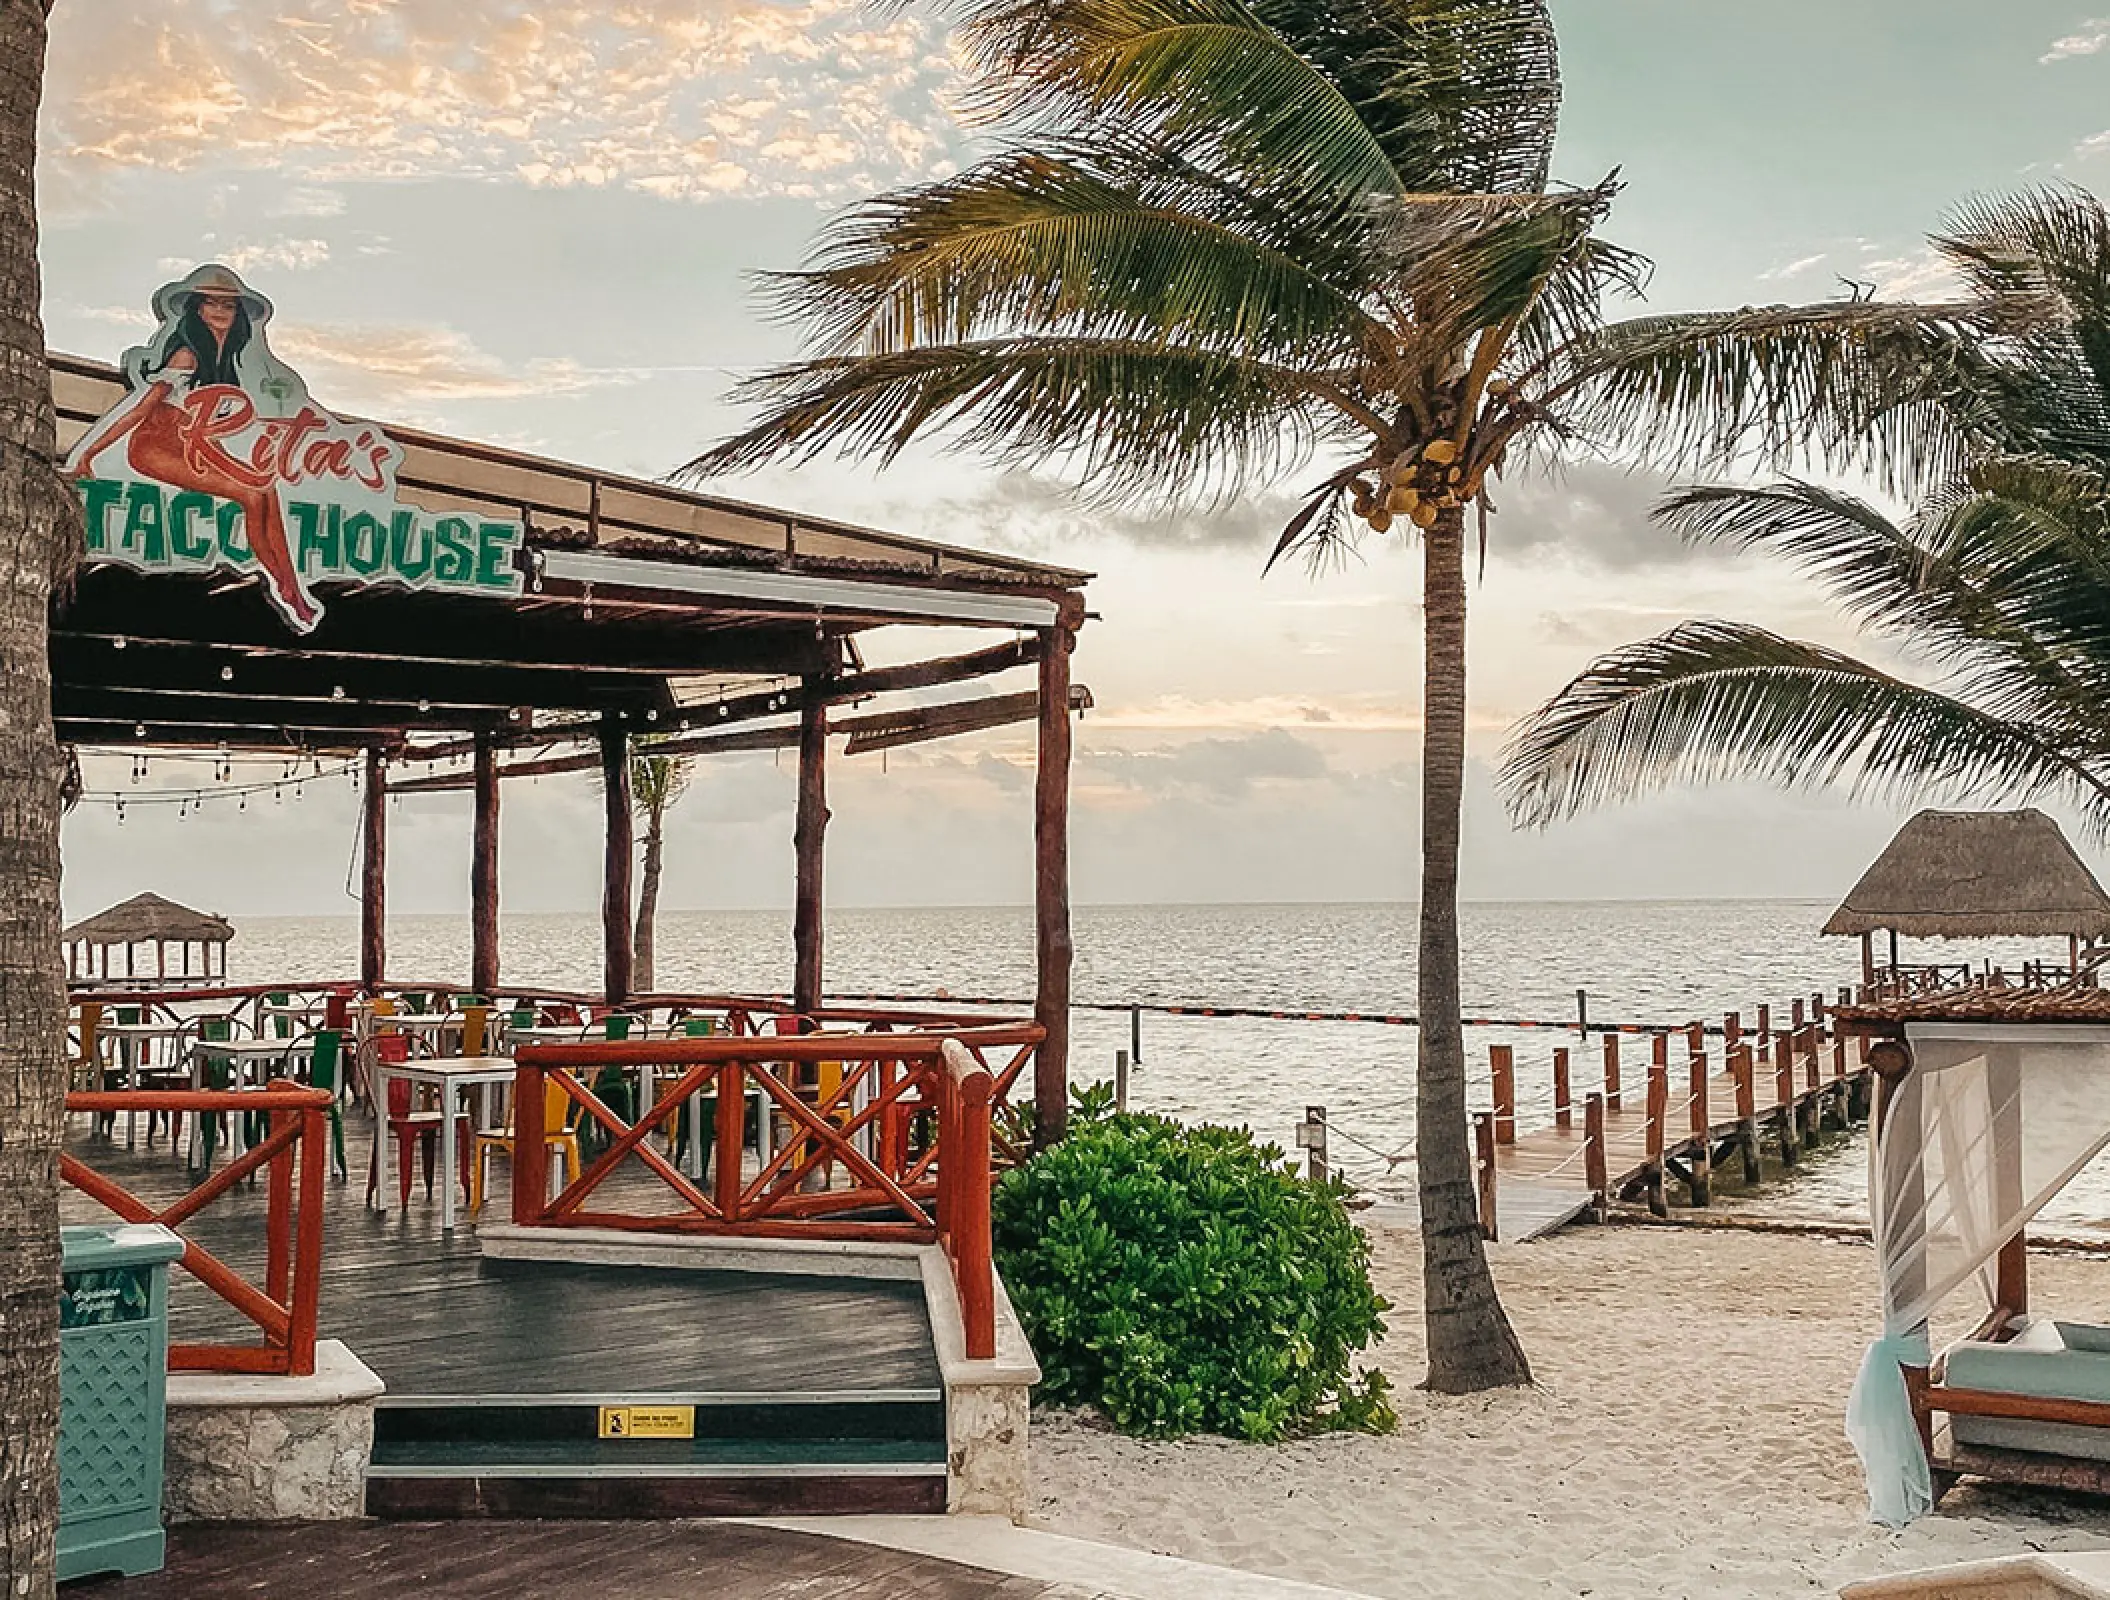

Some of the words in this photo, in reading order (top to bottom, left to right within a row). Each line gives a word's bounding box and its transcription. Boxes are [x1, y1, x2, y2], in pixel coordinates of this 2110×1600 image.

[179, 384, 390, 490] Rita's
[77, 479, 254, 564] TACO
[288, 500, 517, 587] HOUSE
